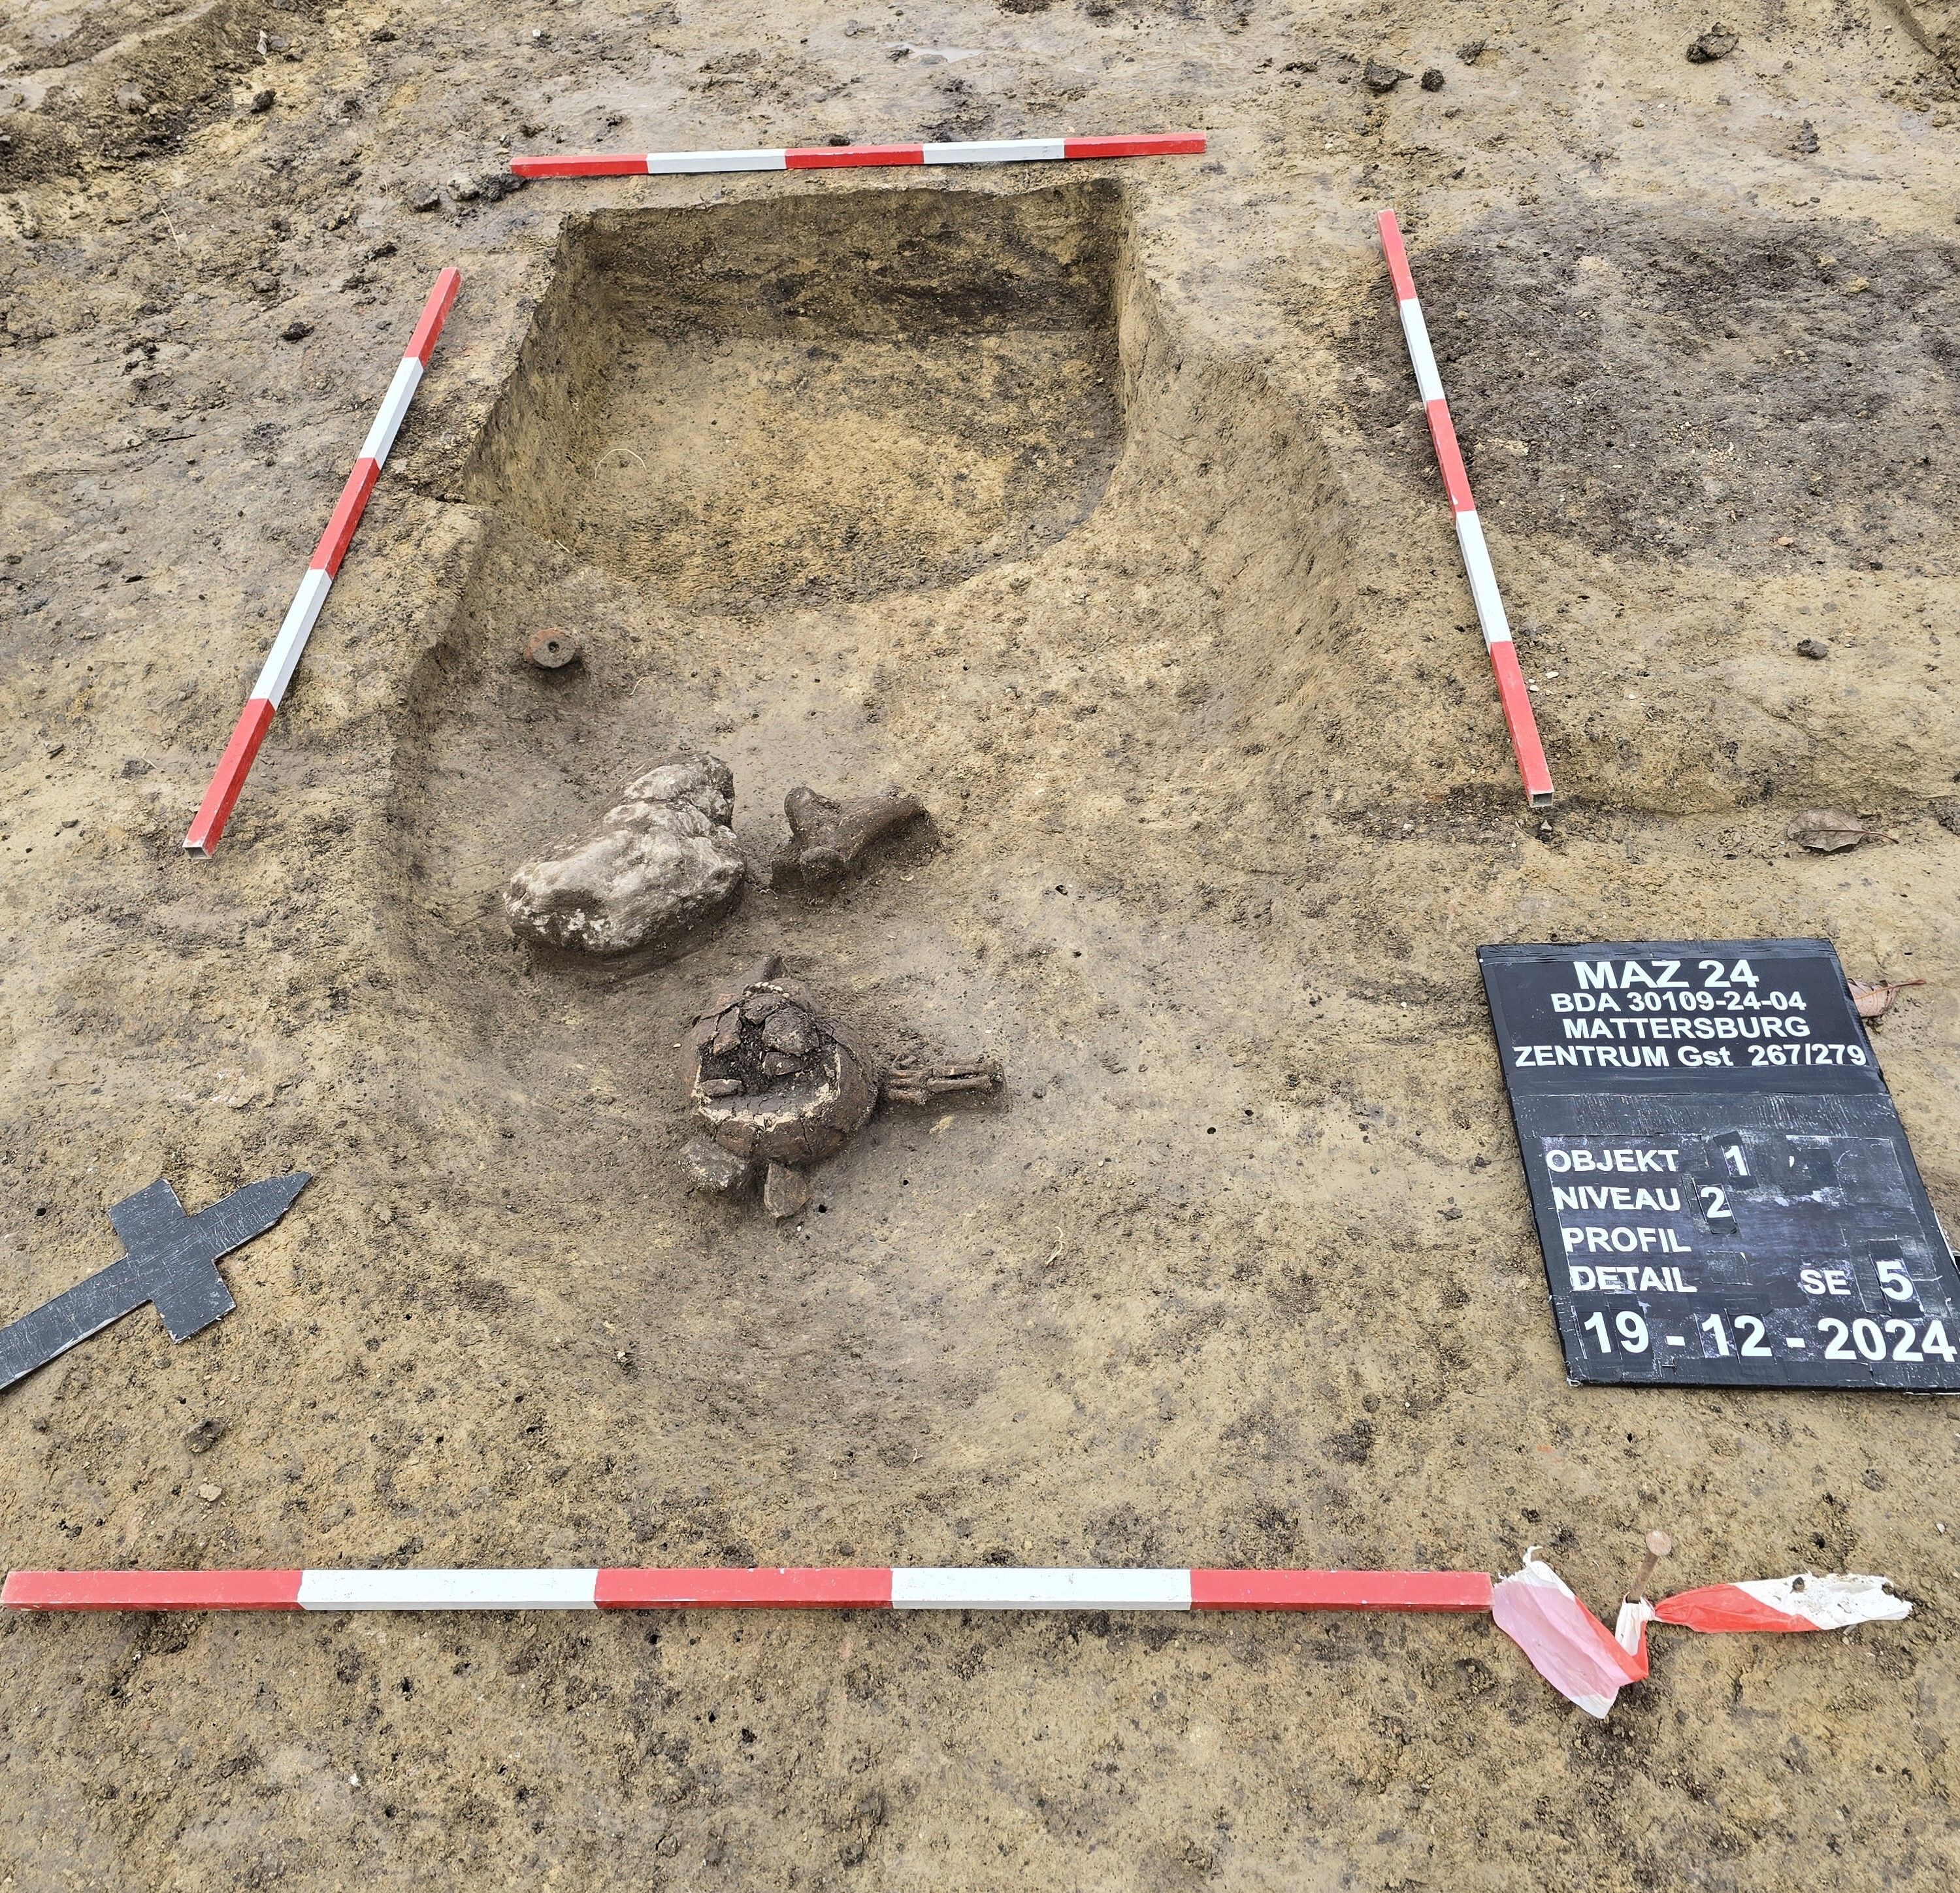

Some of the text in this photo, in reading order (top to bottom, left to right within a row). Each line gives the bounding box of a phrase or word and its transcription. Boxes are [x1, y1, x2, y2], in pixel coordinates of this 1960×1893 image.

[1573, 959, 1759, 989] MAZ 24
[1551, 991, 1807, 1012] BDA 30109-24-04
[1562, 1016, 1810, 1040] MATTERSBURG
[1513, 1044, 1867, 1068] ZENTRUM Gst 267/279
[1546, 1145, 1750, 1176] OBJEKT 1
[1553, 1186, 1733, 1219] NIVEAU 2
[1562, 1227, 1691, 1253] PROFIL
[1569, 1261, 1914, 1300] DETAIL SE 5
[1584, 1311, 1649, 1354] 19
[1701, 1313, 1772, 1357] 12
[1817, 1317, 1958, 1362] 2024
